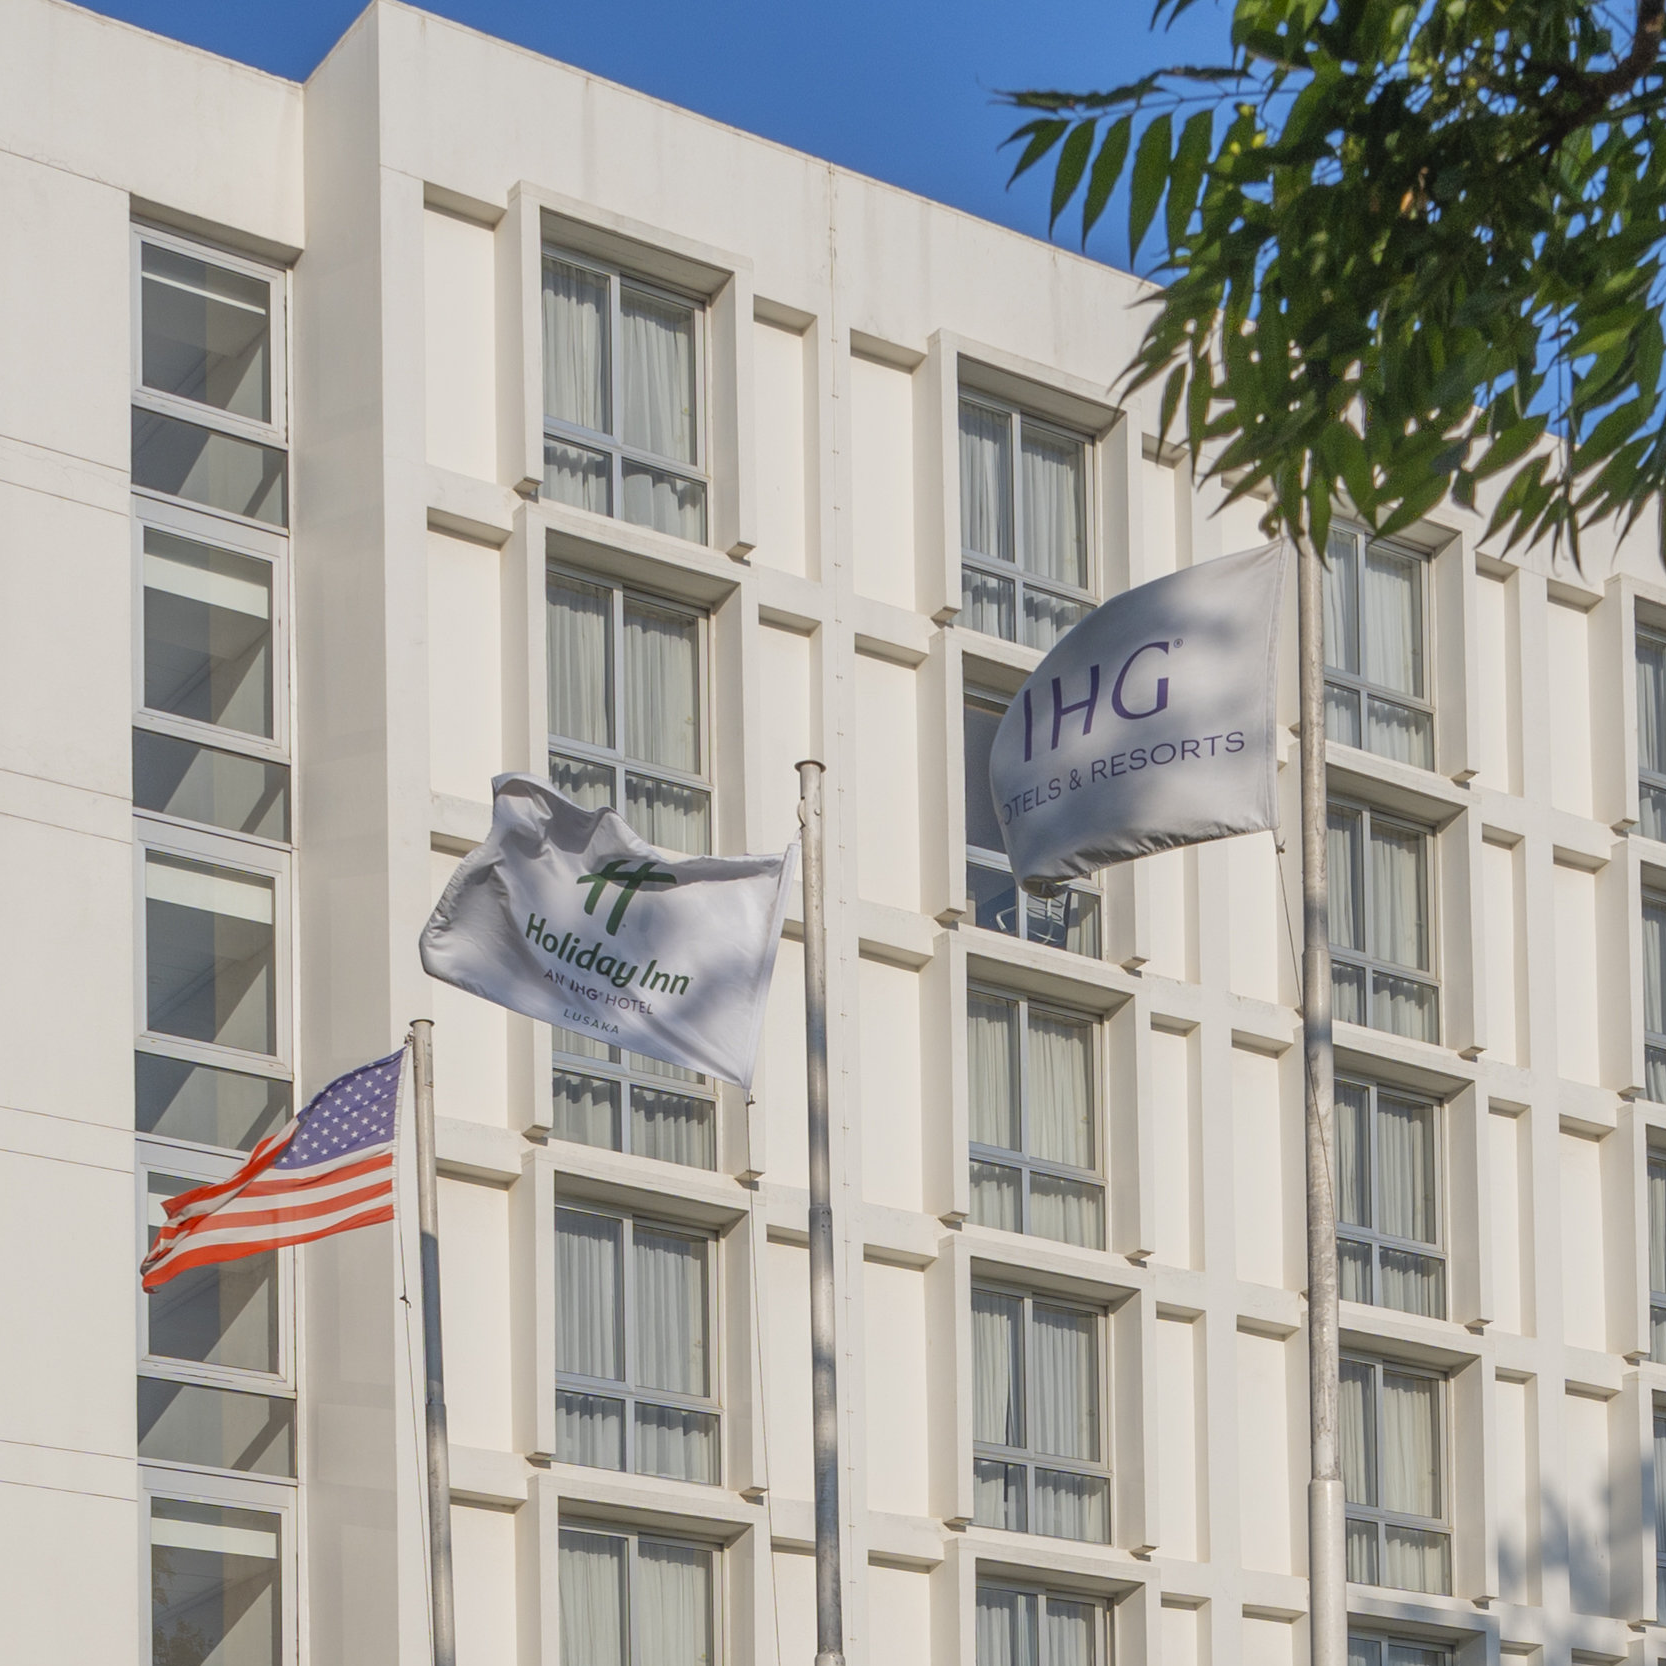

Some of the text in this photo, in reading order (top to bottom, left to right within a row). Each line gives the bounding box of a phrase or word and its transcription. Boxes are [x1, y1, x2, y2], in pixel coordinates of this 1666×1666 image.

[1069, 768, 1082, 791] &
[1091, 731, 1245, 784] RESORTS
[525, 912, 690, 996] Holiday Inn
[544, 968, 565, 986] AN
[605, 993, 654, 1015] HOTEL
[563, 1008, 619, 1034] LUSAKA
